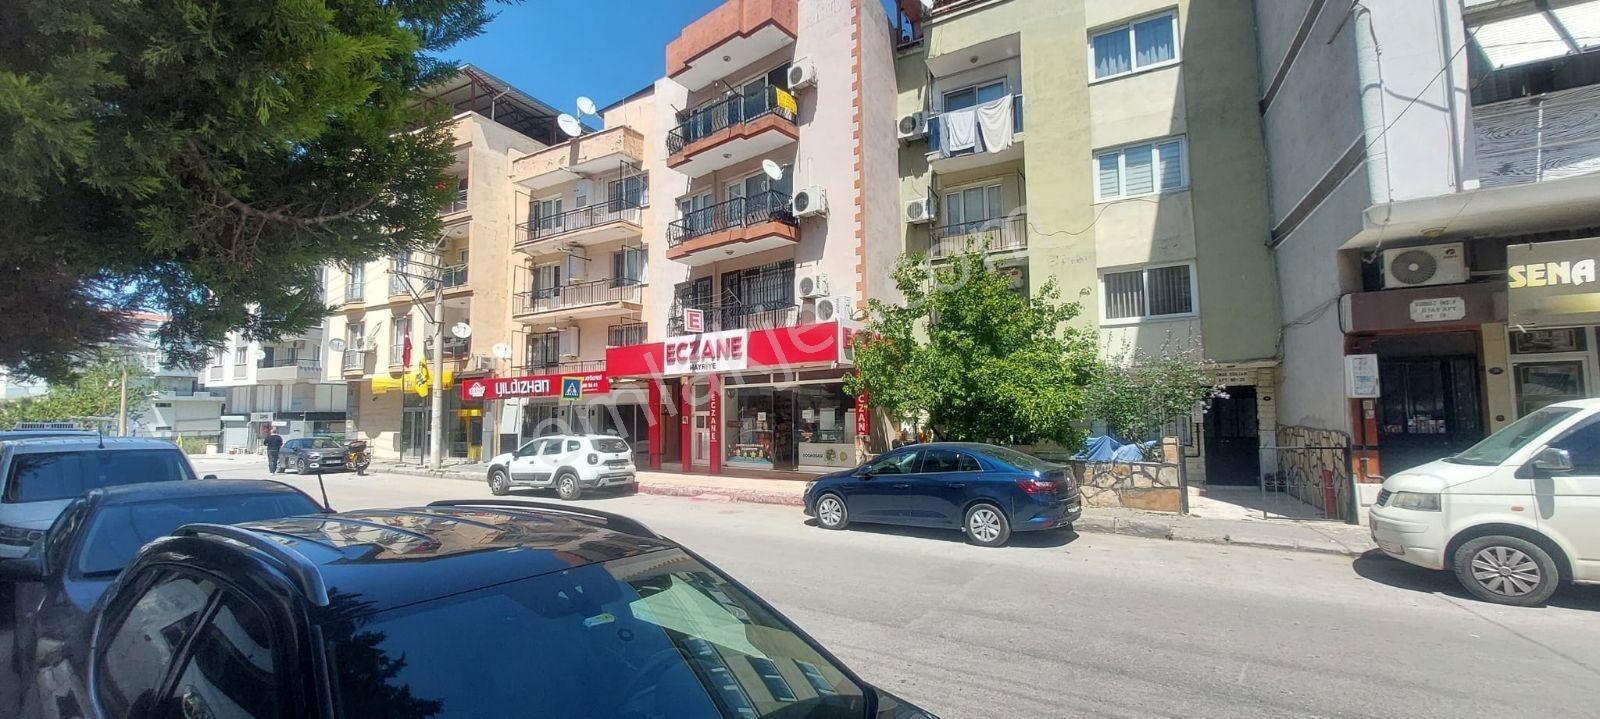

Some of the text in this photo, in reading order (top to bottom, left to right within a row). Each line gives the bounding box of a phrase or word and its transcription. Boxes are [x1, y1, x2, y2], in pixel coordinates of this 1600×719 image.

[1507, 259, 1596, 289] SENA
[689, 313, 700, 328] E
[666, 335, 743, 365] ECZANE
